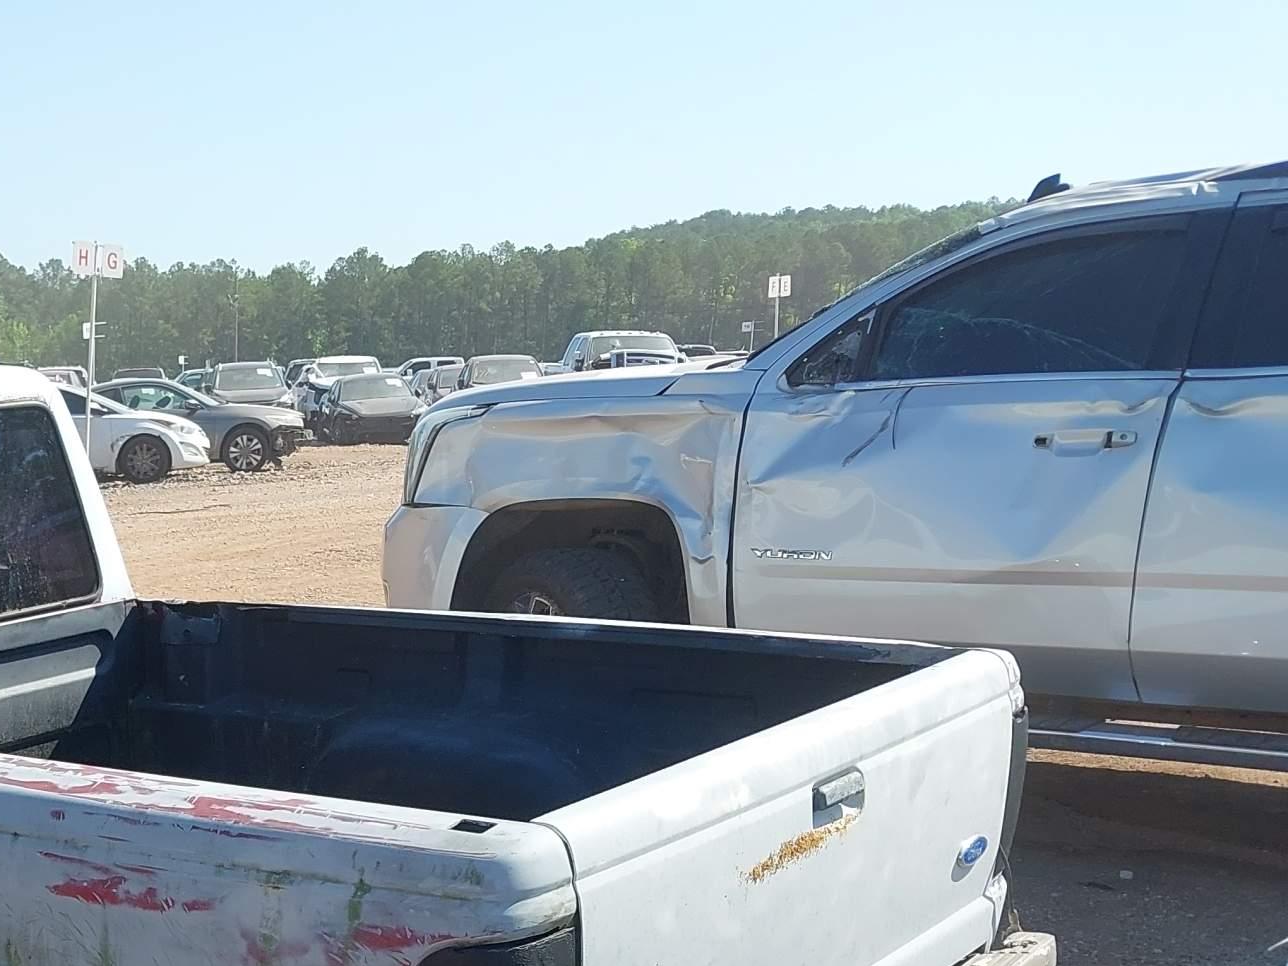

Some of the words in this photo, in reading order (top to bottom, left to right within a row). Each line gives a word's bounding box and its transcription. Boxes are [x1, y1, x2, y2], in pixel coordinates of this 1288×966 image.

[78, 248, 89, 267] H
[107, 252, 118, 270] G
[750, 547, 833, 561] YUKON
